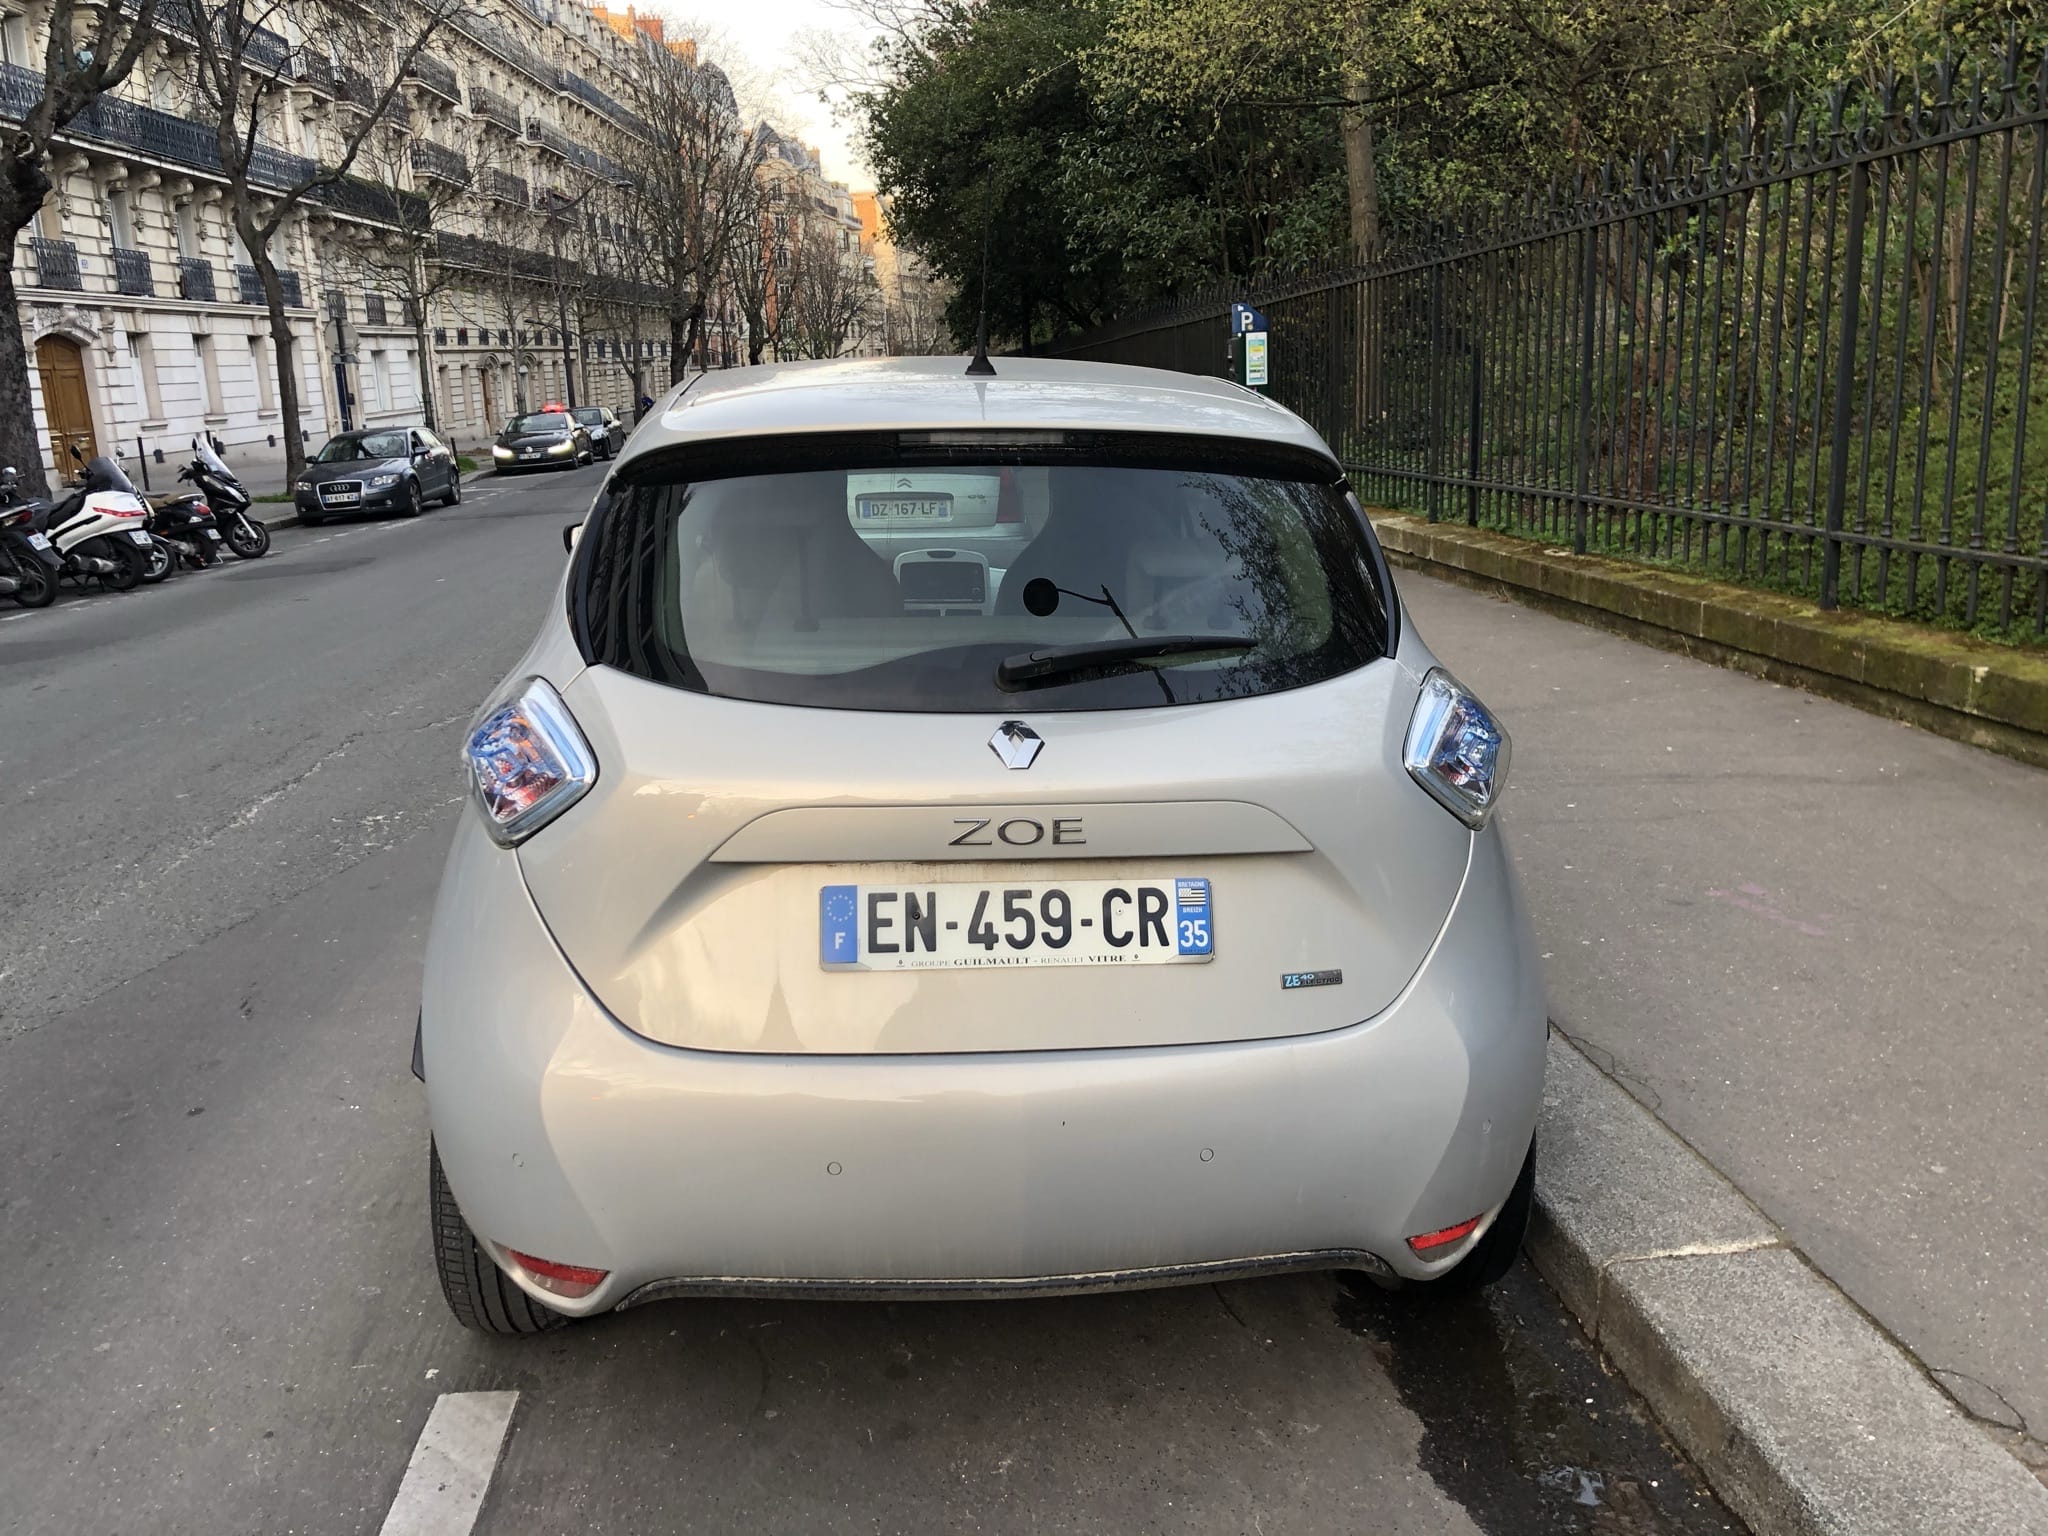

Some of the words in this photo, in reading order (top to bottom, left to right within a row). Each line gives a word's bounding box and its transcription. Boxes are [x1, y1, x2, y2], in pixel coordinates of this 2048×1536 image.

[1241, 312, 1253, 331] P
[948, 817, 1087, 846] ZOE
[867, 887, 1170, 954] EN-459-CR
[834, 932, 846, 950] F
[1179, 920, 1209, 948] 35
[911, 960, 950, 968] GROUPE
[953, 956, 1030, 967] GUILMAULT
